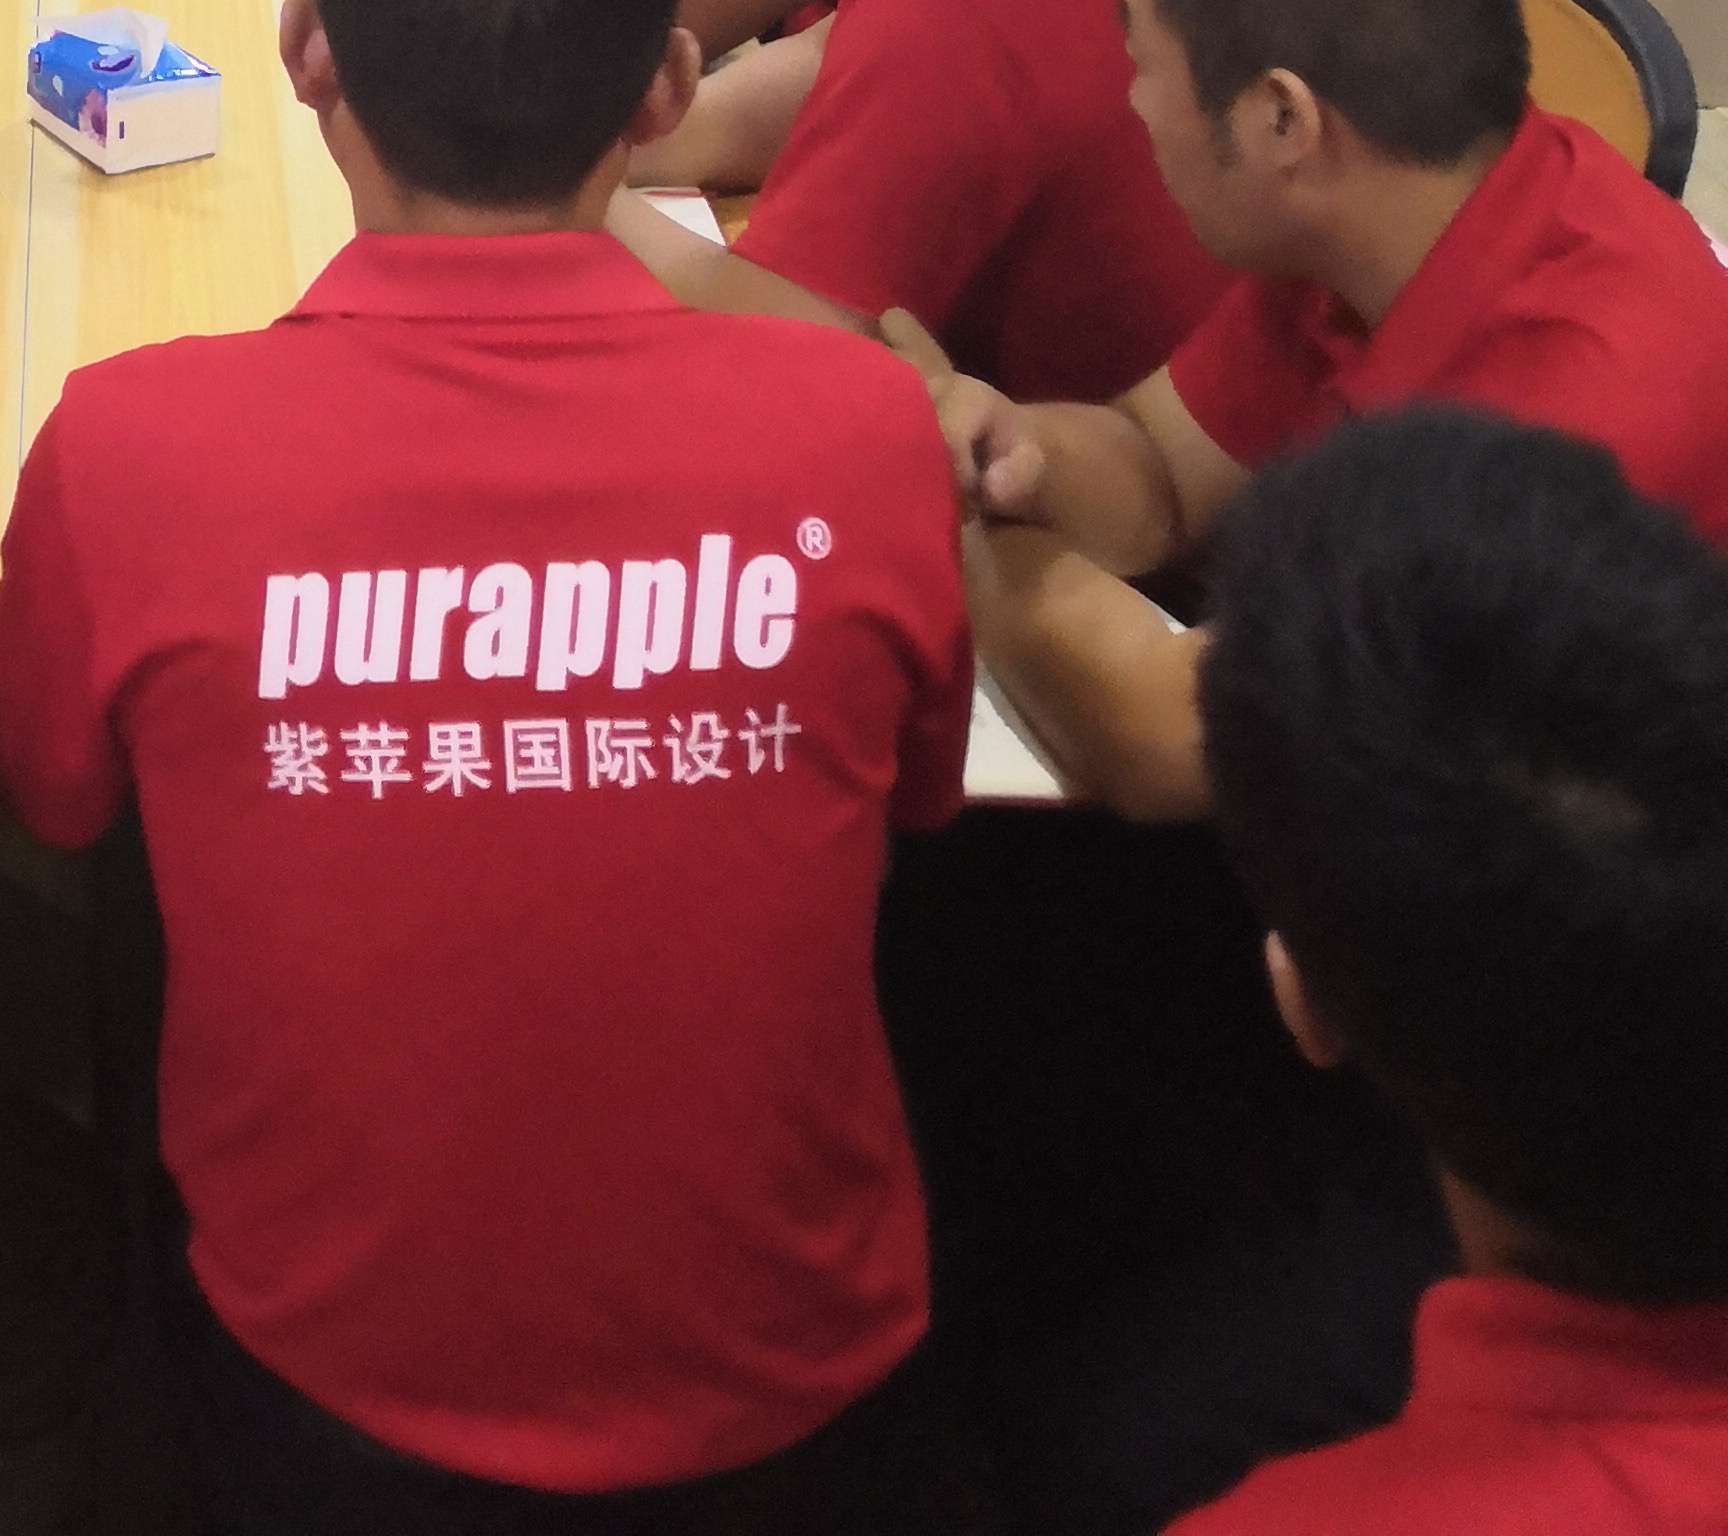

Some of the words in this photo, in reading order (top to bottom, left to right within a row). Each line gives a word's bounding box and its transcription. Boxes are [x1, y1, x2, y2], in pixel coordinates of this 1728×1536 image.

[258, 533, 797, 699] purapple
[263, 703, 802, 799] 紫苹果国际设计
